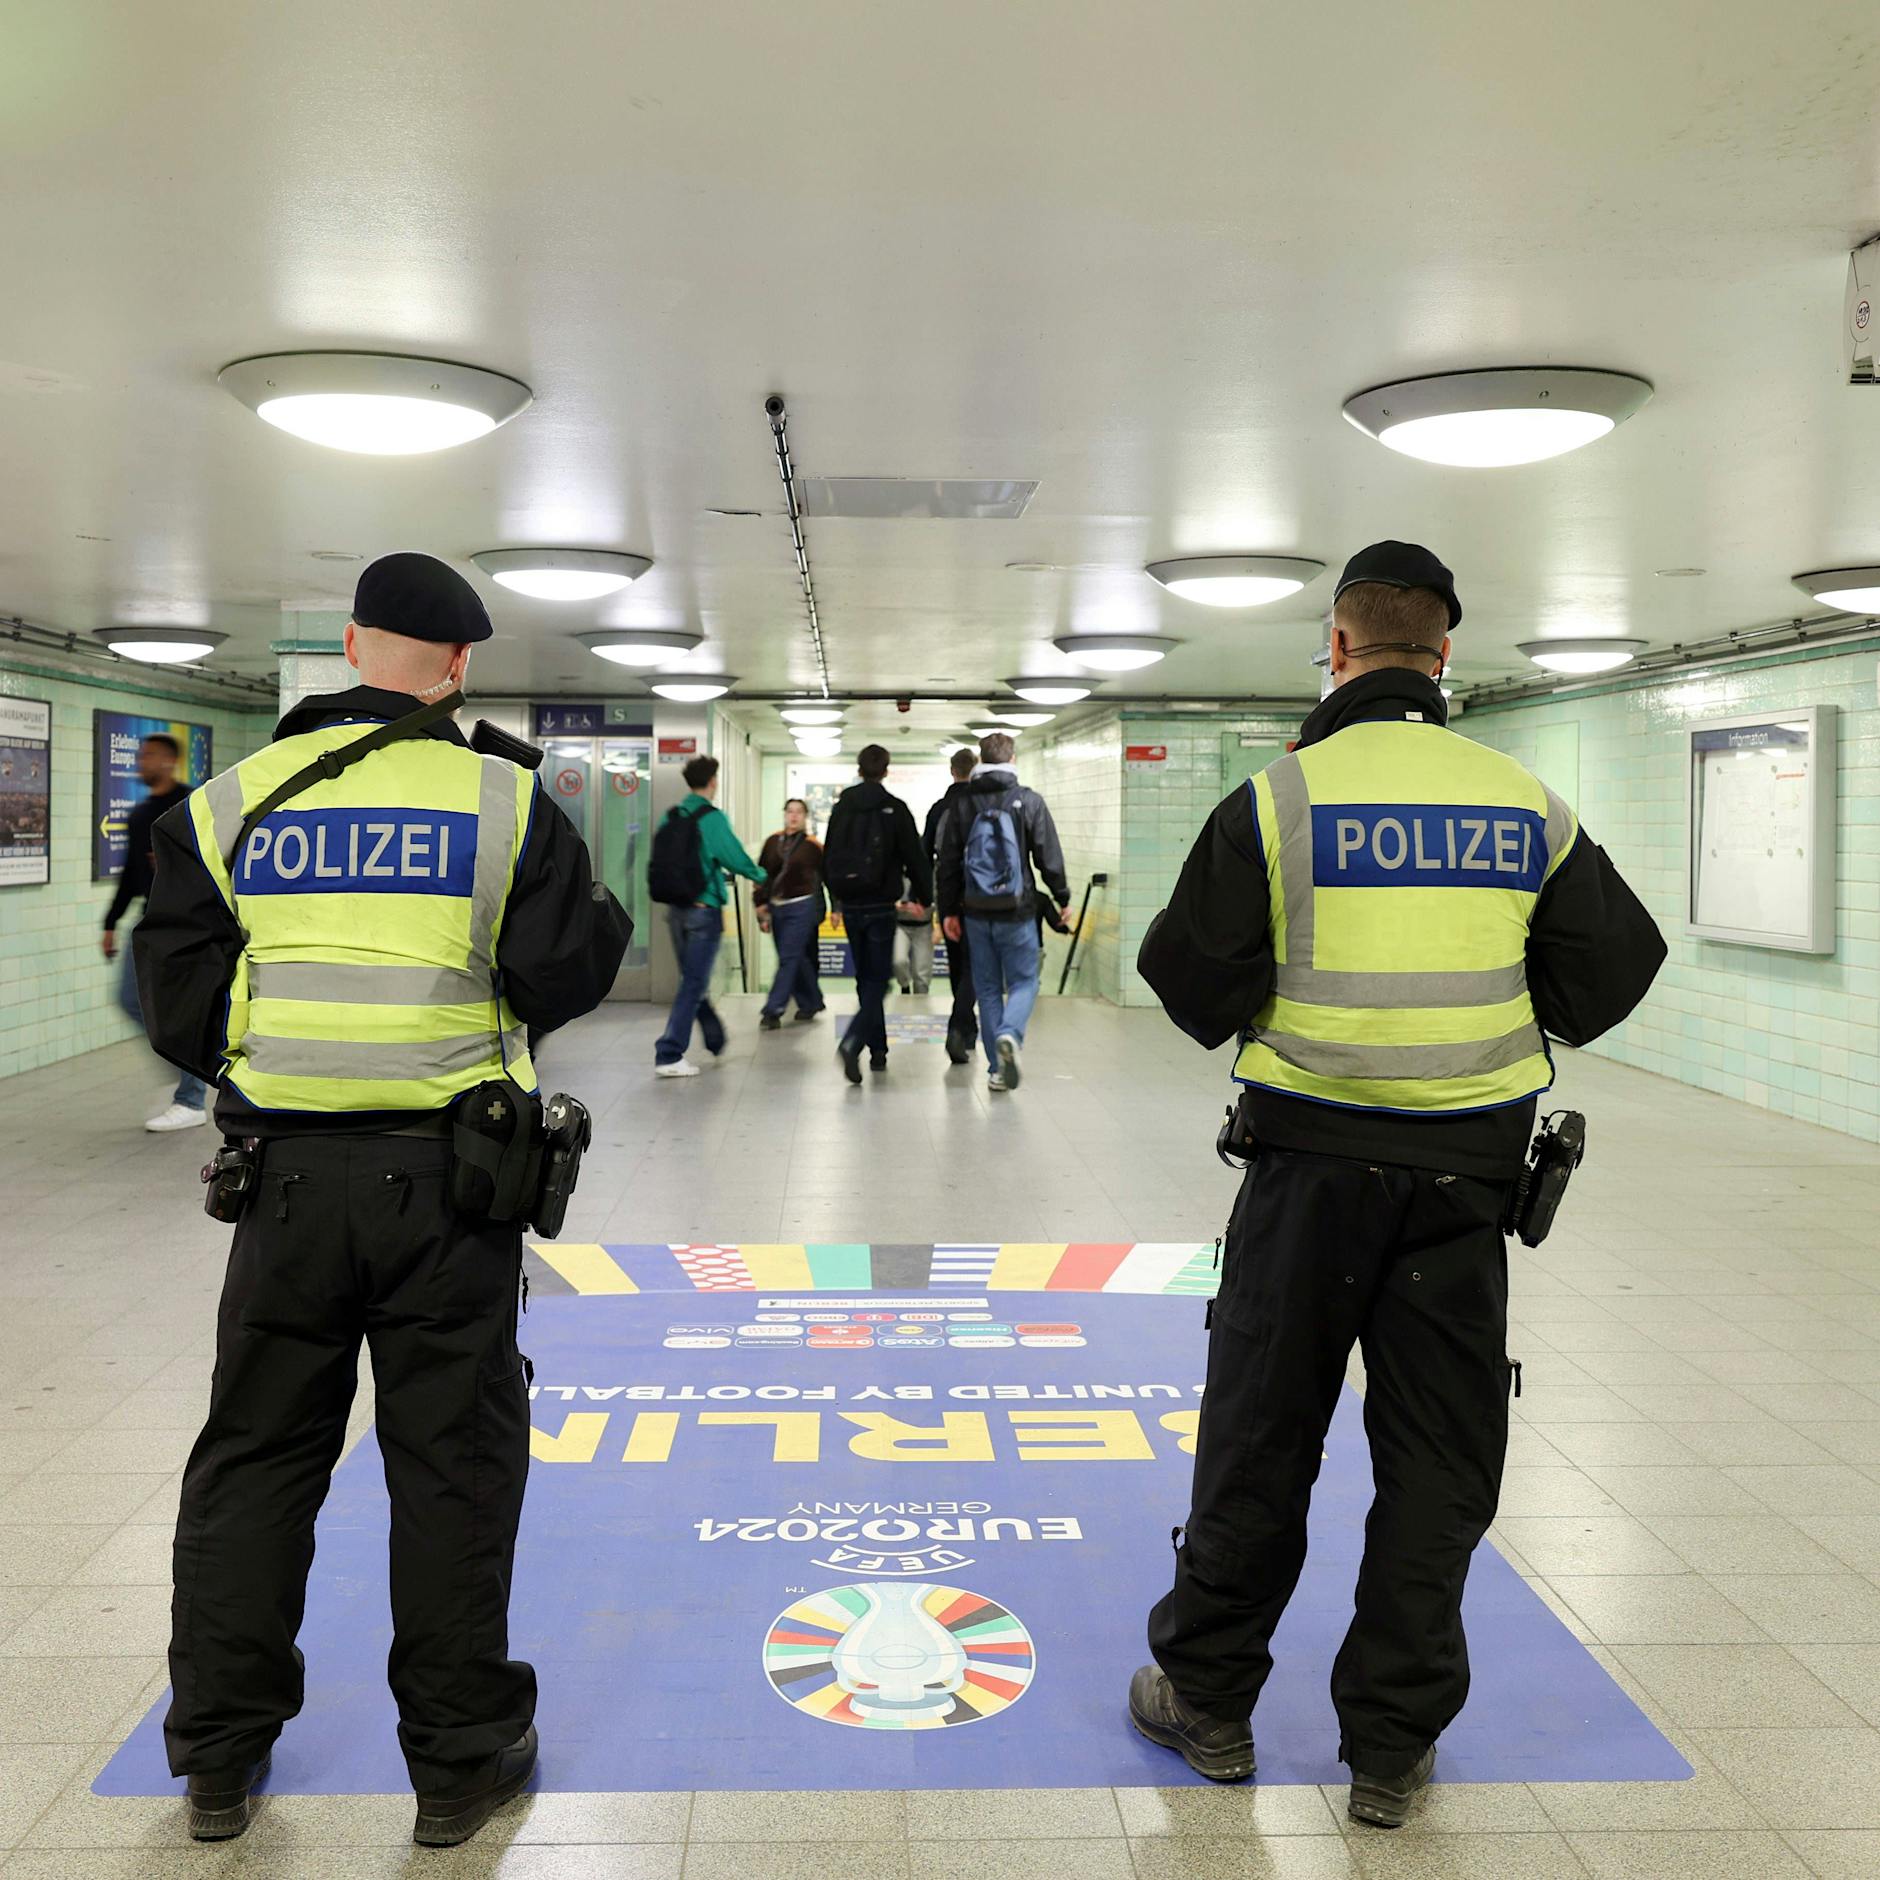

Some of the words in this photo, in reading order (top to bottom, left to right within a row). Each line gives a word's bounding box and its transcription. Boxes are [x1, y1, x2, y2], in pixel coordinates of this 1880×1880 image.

[614, 708, 625, 721] S
[111, 733, 140, 750] Erlebnis
[1728, 732, 1769, 747] Information
[111, 749, 135, 768] Europa
[243, 823, 449, 880] POLIZEI
[1336, 817, 1541, 874] POLIZEI
[669, 1327, 732, 1335] vivo
[851, 1385, 934, 1400] BY
[948, 1384, 1182, 1400] UNITED
[787, 1501, 992, 1515] GERMANY
[693, 1517, 1084, 1542] EURO2024
[827, 1547, 966, 1572] UEFA
